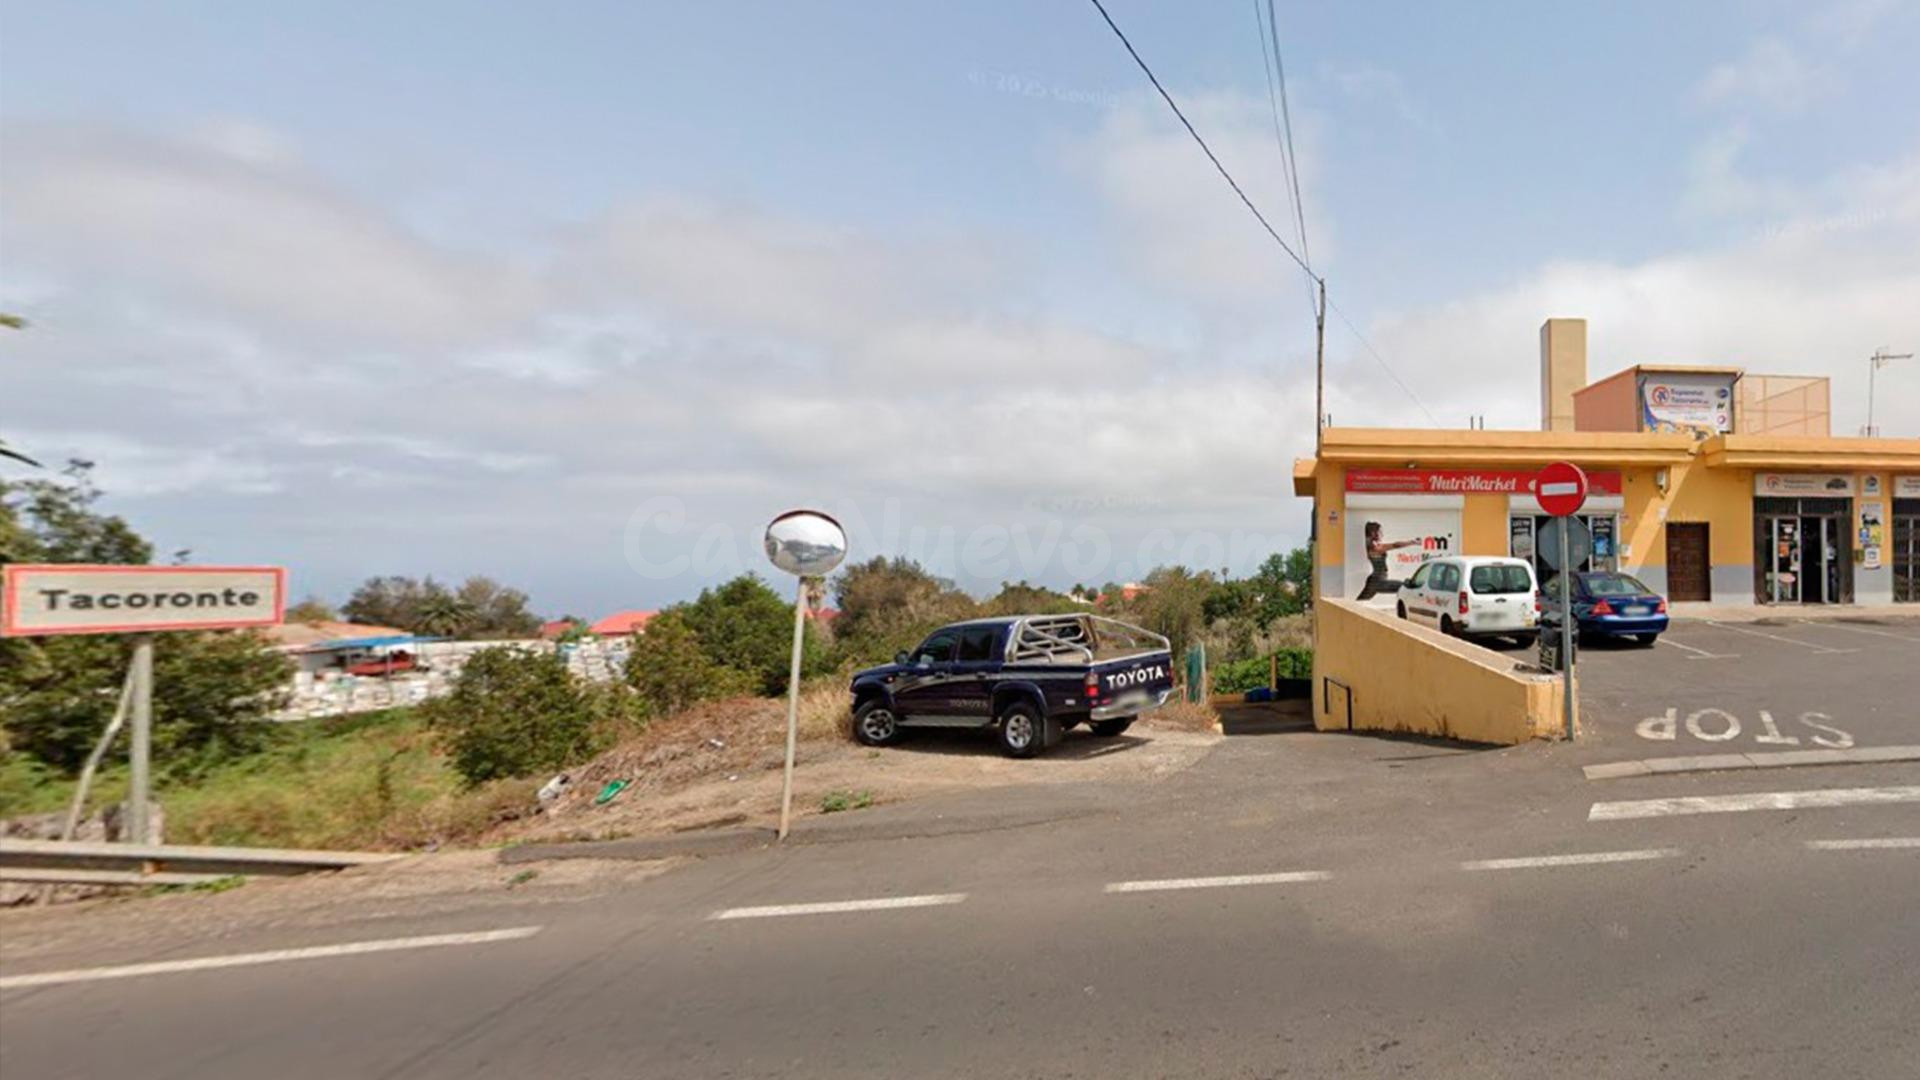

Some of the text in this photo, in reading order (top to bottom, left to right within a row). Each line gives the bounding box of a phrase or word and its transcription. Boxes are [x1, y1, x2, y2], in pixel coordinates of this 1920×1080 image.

[1429, 475, 1517, 491] NutriMarket
[38, 587, 260, 611] Tacoronte
[1105, 665, 1164, 690] TOYOTA
[1634, 707, 1855, 748] STOP
